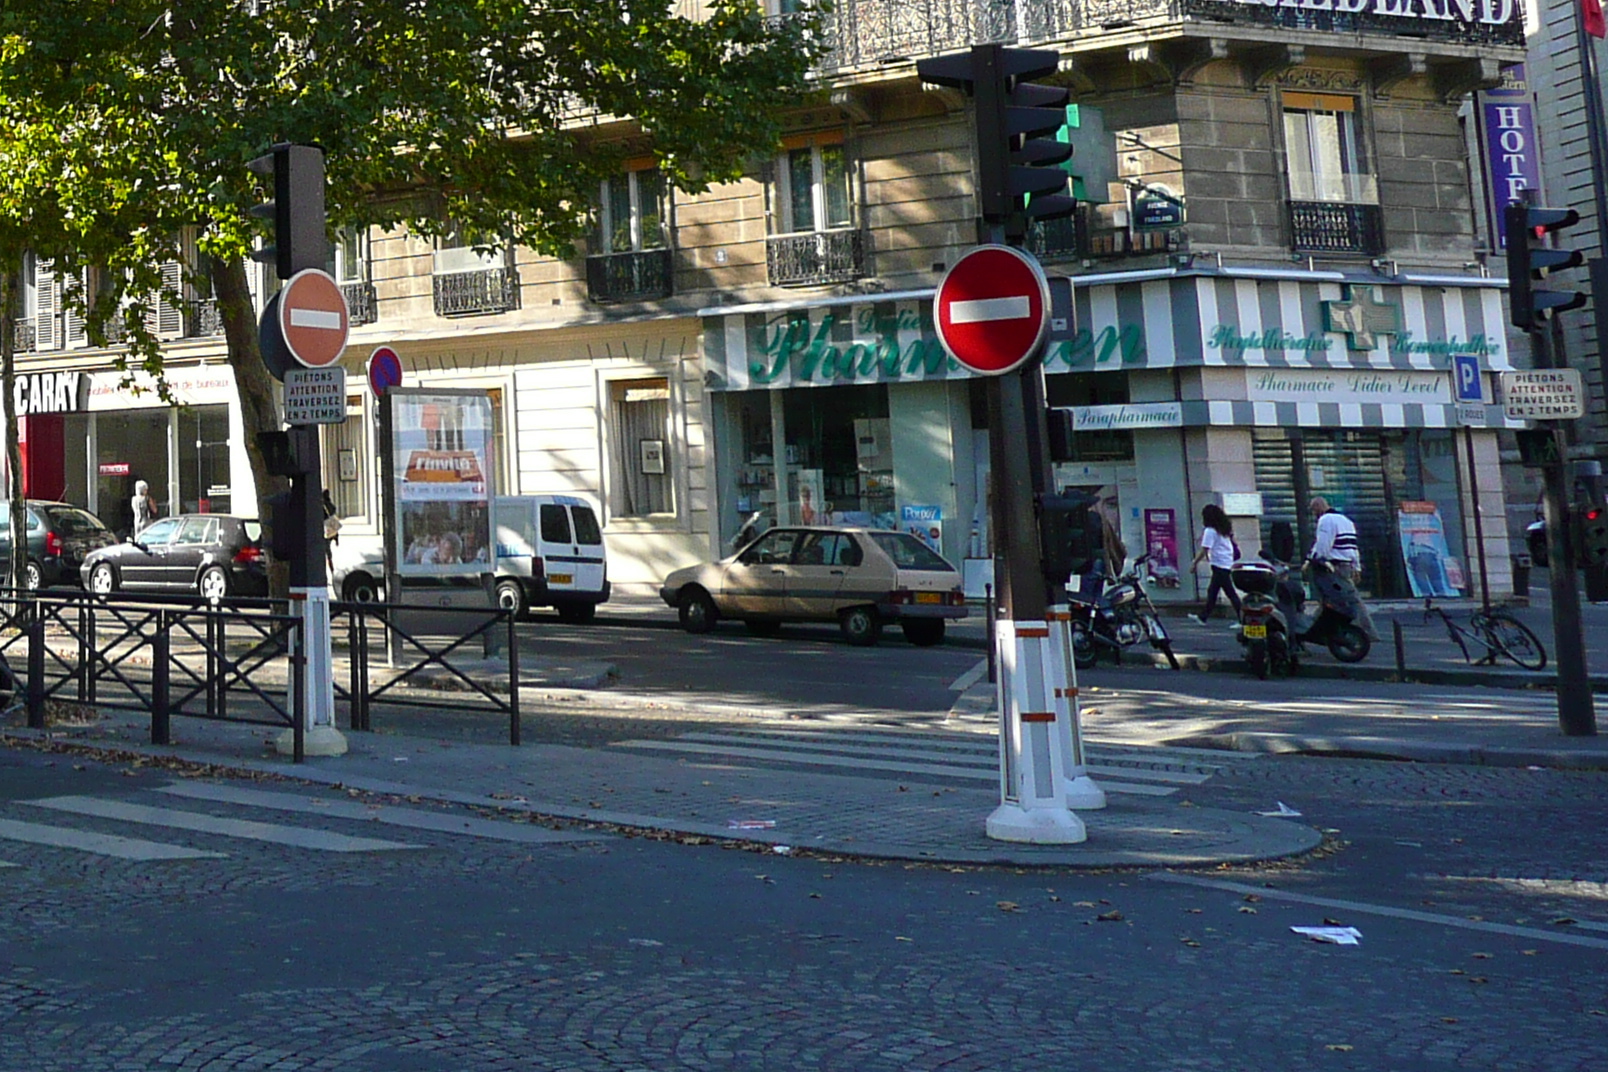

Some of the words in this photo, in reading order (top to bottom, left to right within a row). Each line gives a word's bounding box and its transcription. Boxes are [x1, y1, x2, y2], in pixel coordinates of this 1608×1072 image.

[1495, 106, 1528, 206] HOTE
[294, 372, 333, 383] PIÉTONS
[1255, 371, 1335, 392] Pharmacie
[1461, 363, 1474, 392] P
[13, 371, 80, 417] CARAY
[290, 384, 339, 396] ATTENTION
[1510, 384, 1573, 395] ATTENTION
[288, 396, 340, 408] TRAVERSEZ
[1509, 395, 1576, 405] TRAVERSEZ
[287, 411, 300, 420] EN
[302, 410, 308, 420] 2
[310, 408, 341, 419] TEMPS
[1509, 408, 1523, 416] EN
[1528, 407, 1535, 415] 2
[1539, 405, 1578, 415] TEMPS
[1077, 407, 1179, 428] Parapharmacie
